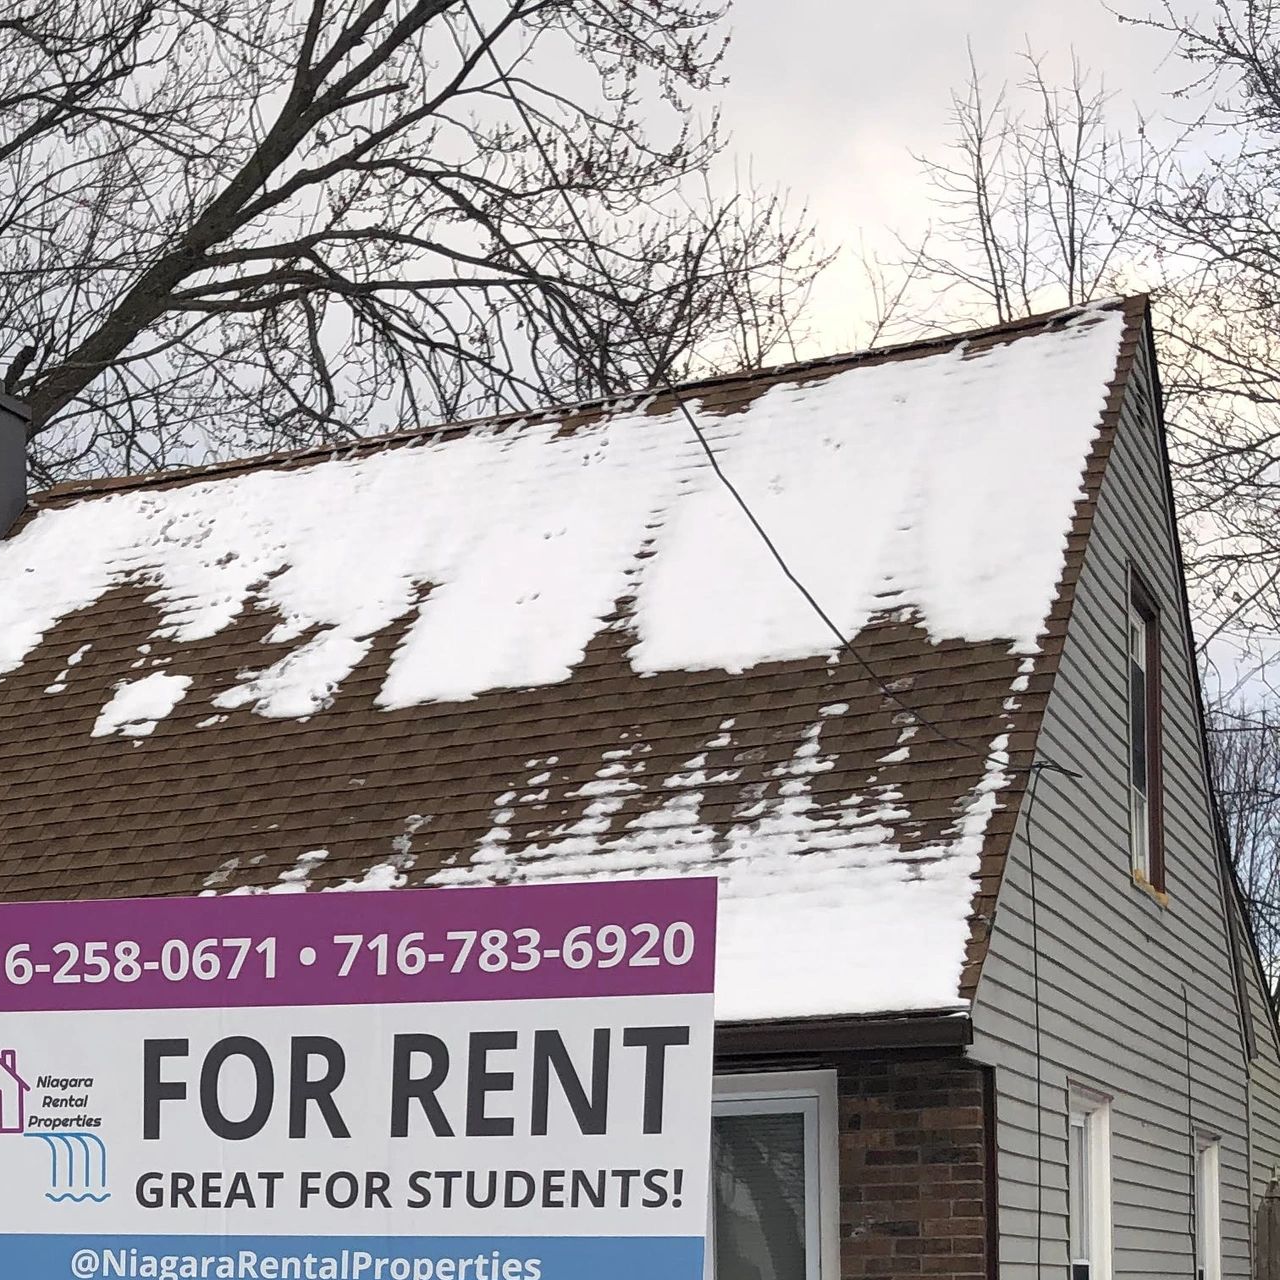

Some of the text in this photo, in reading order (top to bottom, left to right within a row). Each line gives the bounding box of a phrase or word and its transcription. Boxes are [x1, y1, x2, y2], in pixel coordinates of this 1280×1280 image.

[333, 921, 695, 977] 716-783-6920
[36, 1075, 94, 1091] Niagara
[142, 1025, 690, 1141] FOR RENT
[41, 1094, 89, 1109] Rental
[27, 1114, 102, 1131] Properties
[135, 1168, 684, 1209] GREAT FOR STUDENTS!
